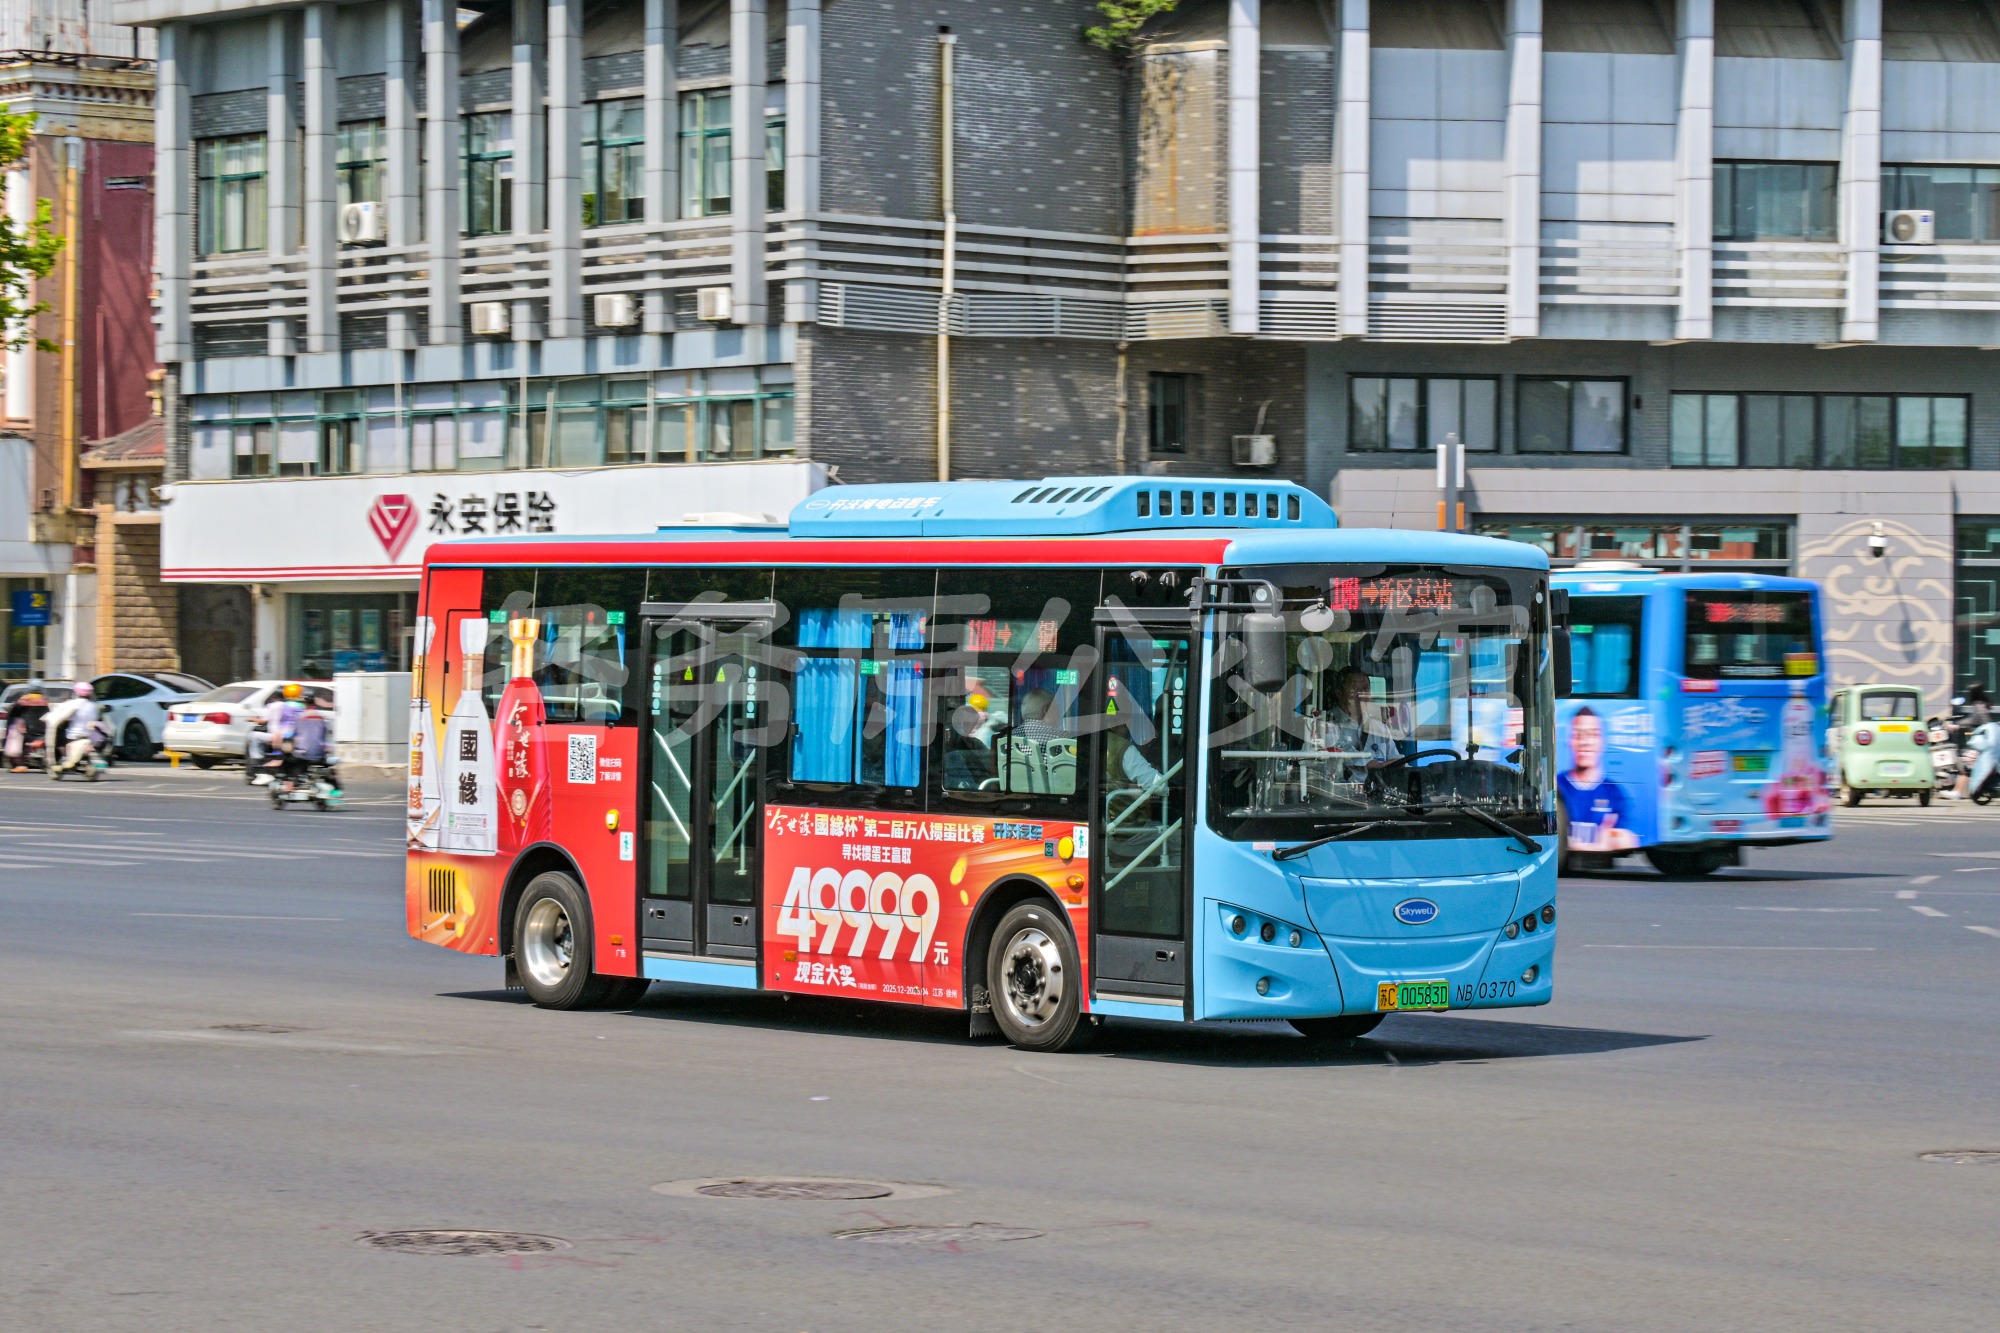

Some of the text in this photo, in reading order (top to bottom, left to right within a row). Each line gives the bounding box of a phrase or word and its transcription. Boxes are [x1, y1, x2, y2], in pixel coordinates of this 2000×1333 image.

[428, 491, 557, 535] 永安保险
[1380, 578, 1453, 610] 新区总站
[459, 730, 478, 806] 國緣
[842, 843, 912, 865] 寻找掼蛋王赢取
[776, 866, 949, 965] 49999 元
[1400, 907, 1434, 917] Skywell
[794, 961, 857, 988] 现金大奖
[1478, 980, 1516, 999] 0370
